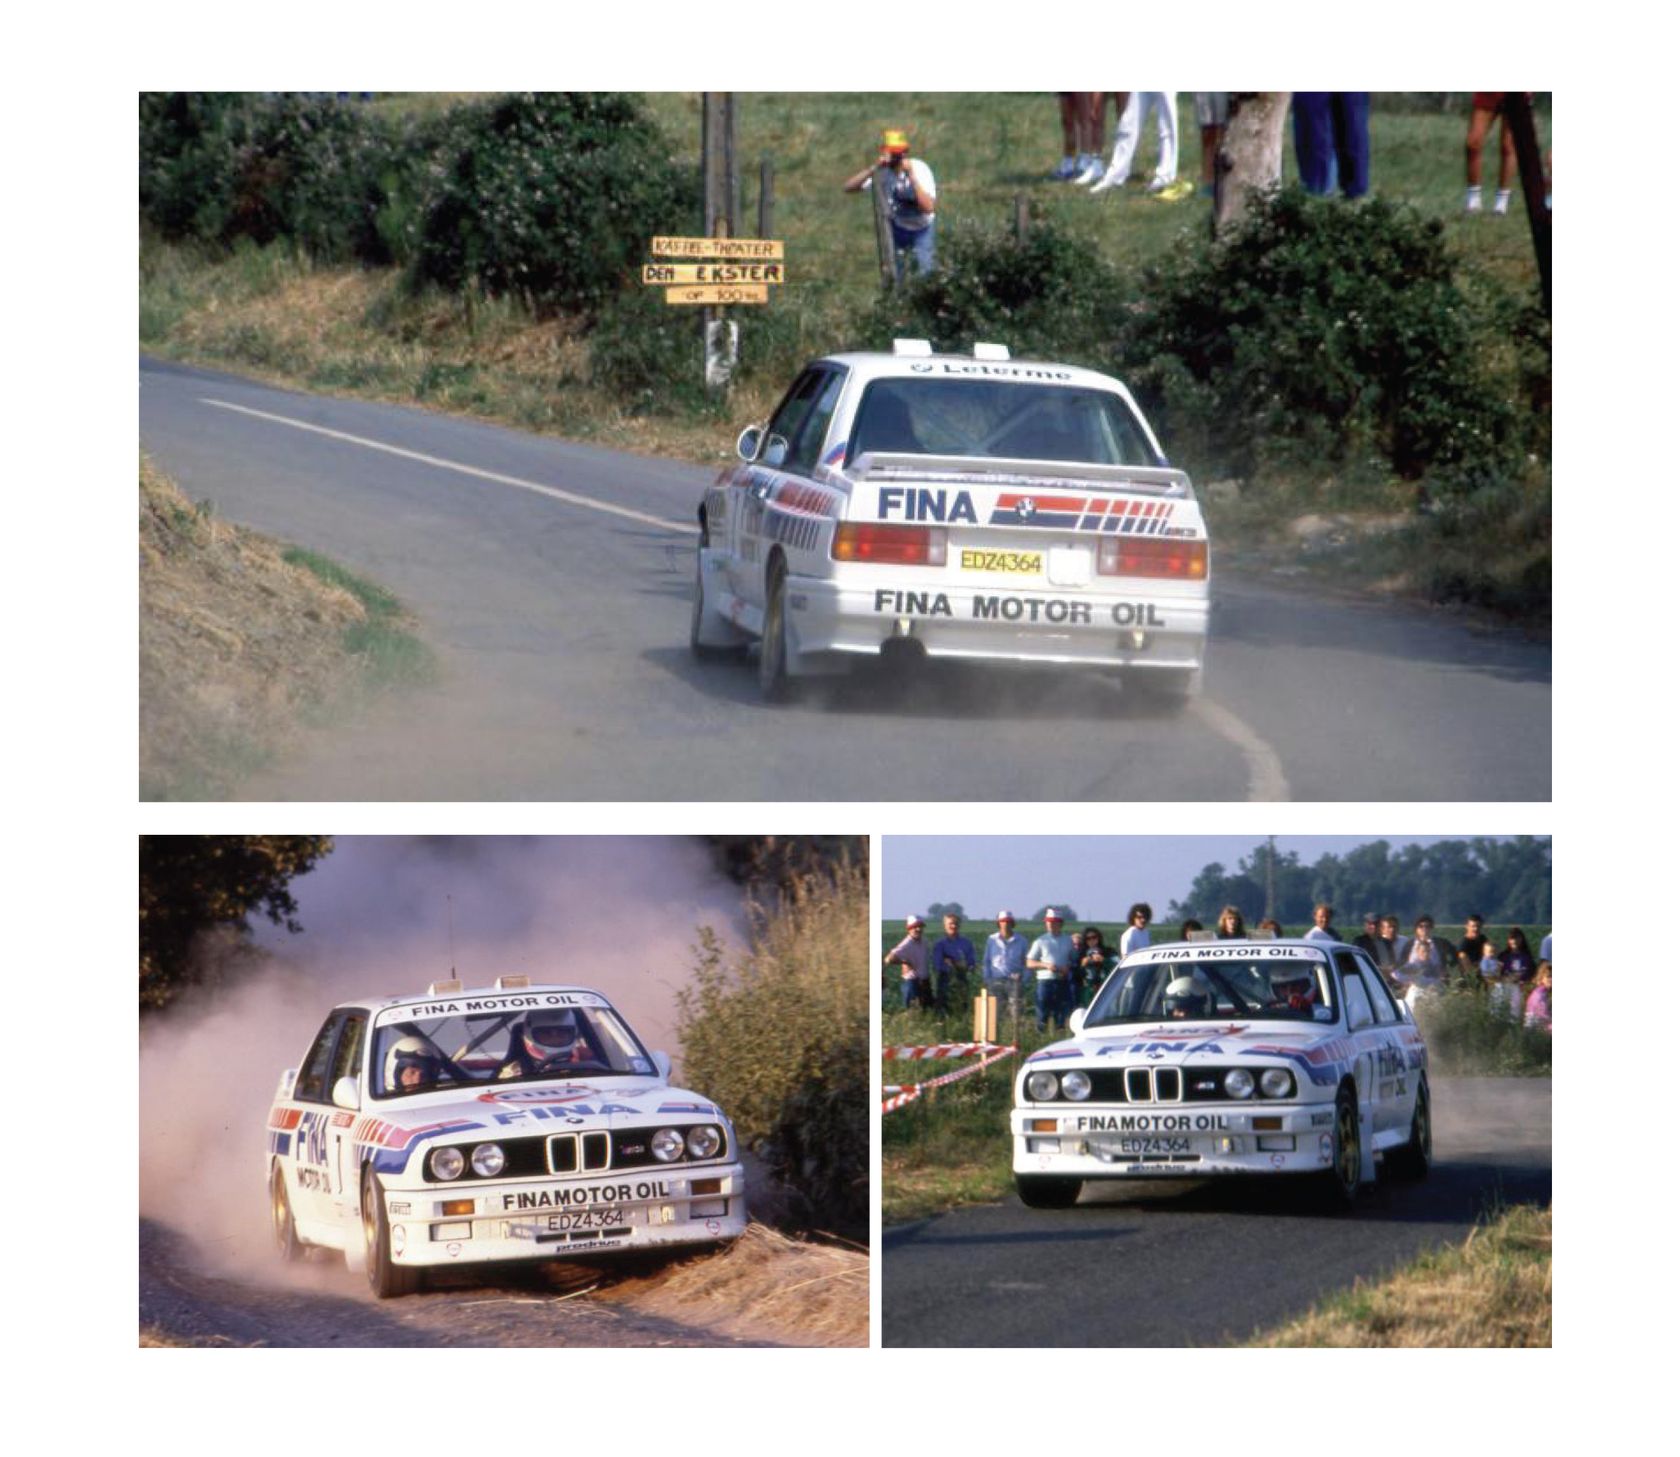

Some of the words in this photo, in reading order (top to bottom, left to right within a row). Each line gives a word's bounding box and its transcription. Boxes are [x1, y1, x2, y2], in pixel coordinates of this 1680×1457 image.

[647, 267, 675, 281] DEN
[877, 486, 977, 524] FINA
[961, 549, 1041, 573] EDZ4364
[873, 588, 953, 616] FINA
[971, 595, 1092, 625] MOTOR
[1111, 602, 1165, 628] OIL
[1151, 950, 1191, 961] FINA
[1197, 947, 1262, 959] MOTOR
[1268, 947, 1299, 958] OIL
[411, 1003, 461, 1017] FINA
[466, 997, 540, 1011] MOTOR
[546, 994, 580, 1006] OIL
[1096, 1041, 1224, 1056] FINA
[492, 1103, 643, 1126] FINA
[1196, 1114, 1227, 1130] OIL
[296, 1110, 330, 1168] FINA
[1121, 1135, 1191, 1153] EDZ4364
[636, 1181, 670, 1199] OIL
[548, 1209, 624, 1232] EDZ4364
[556, 1238, 621, 1253] prodrive
